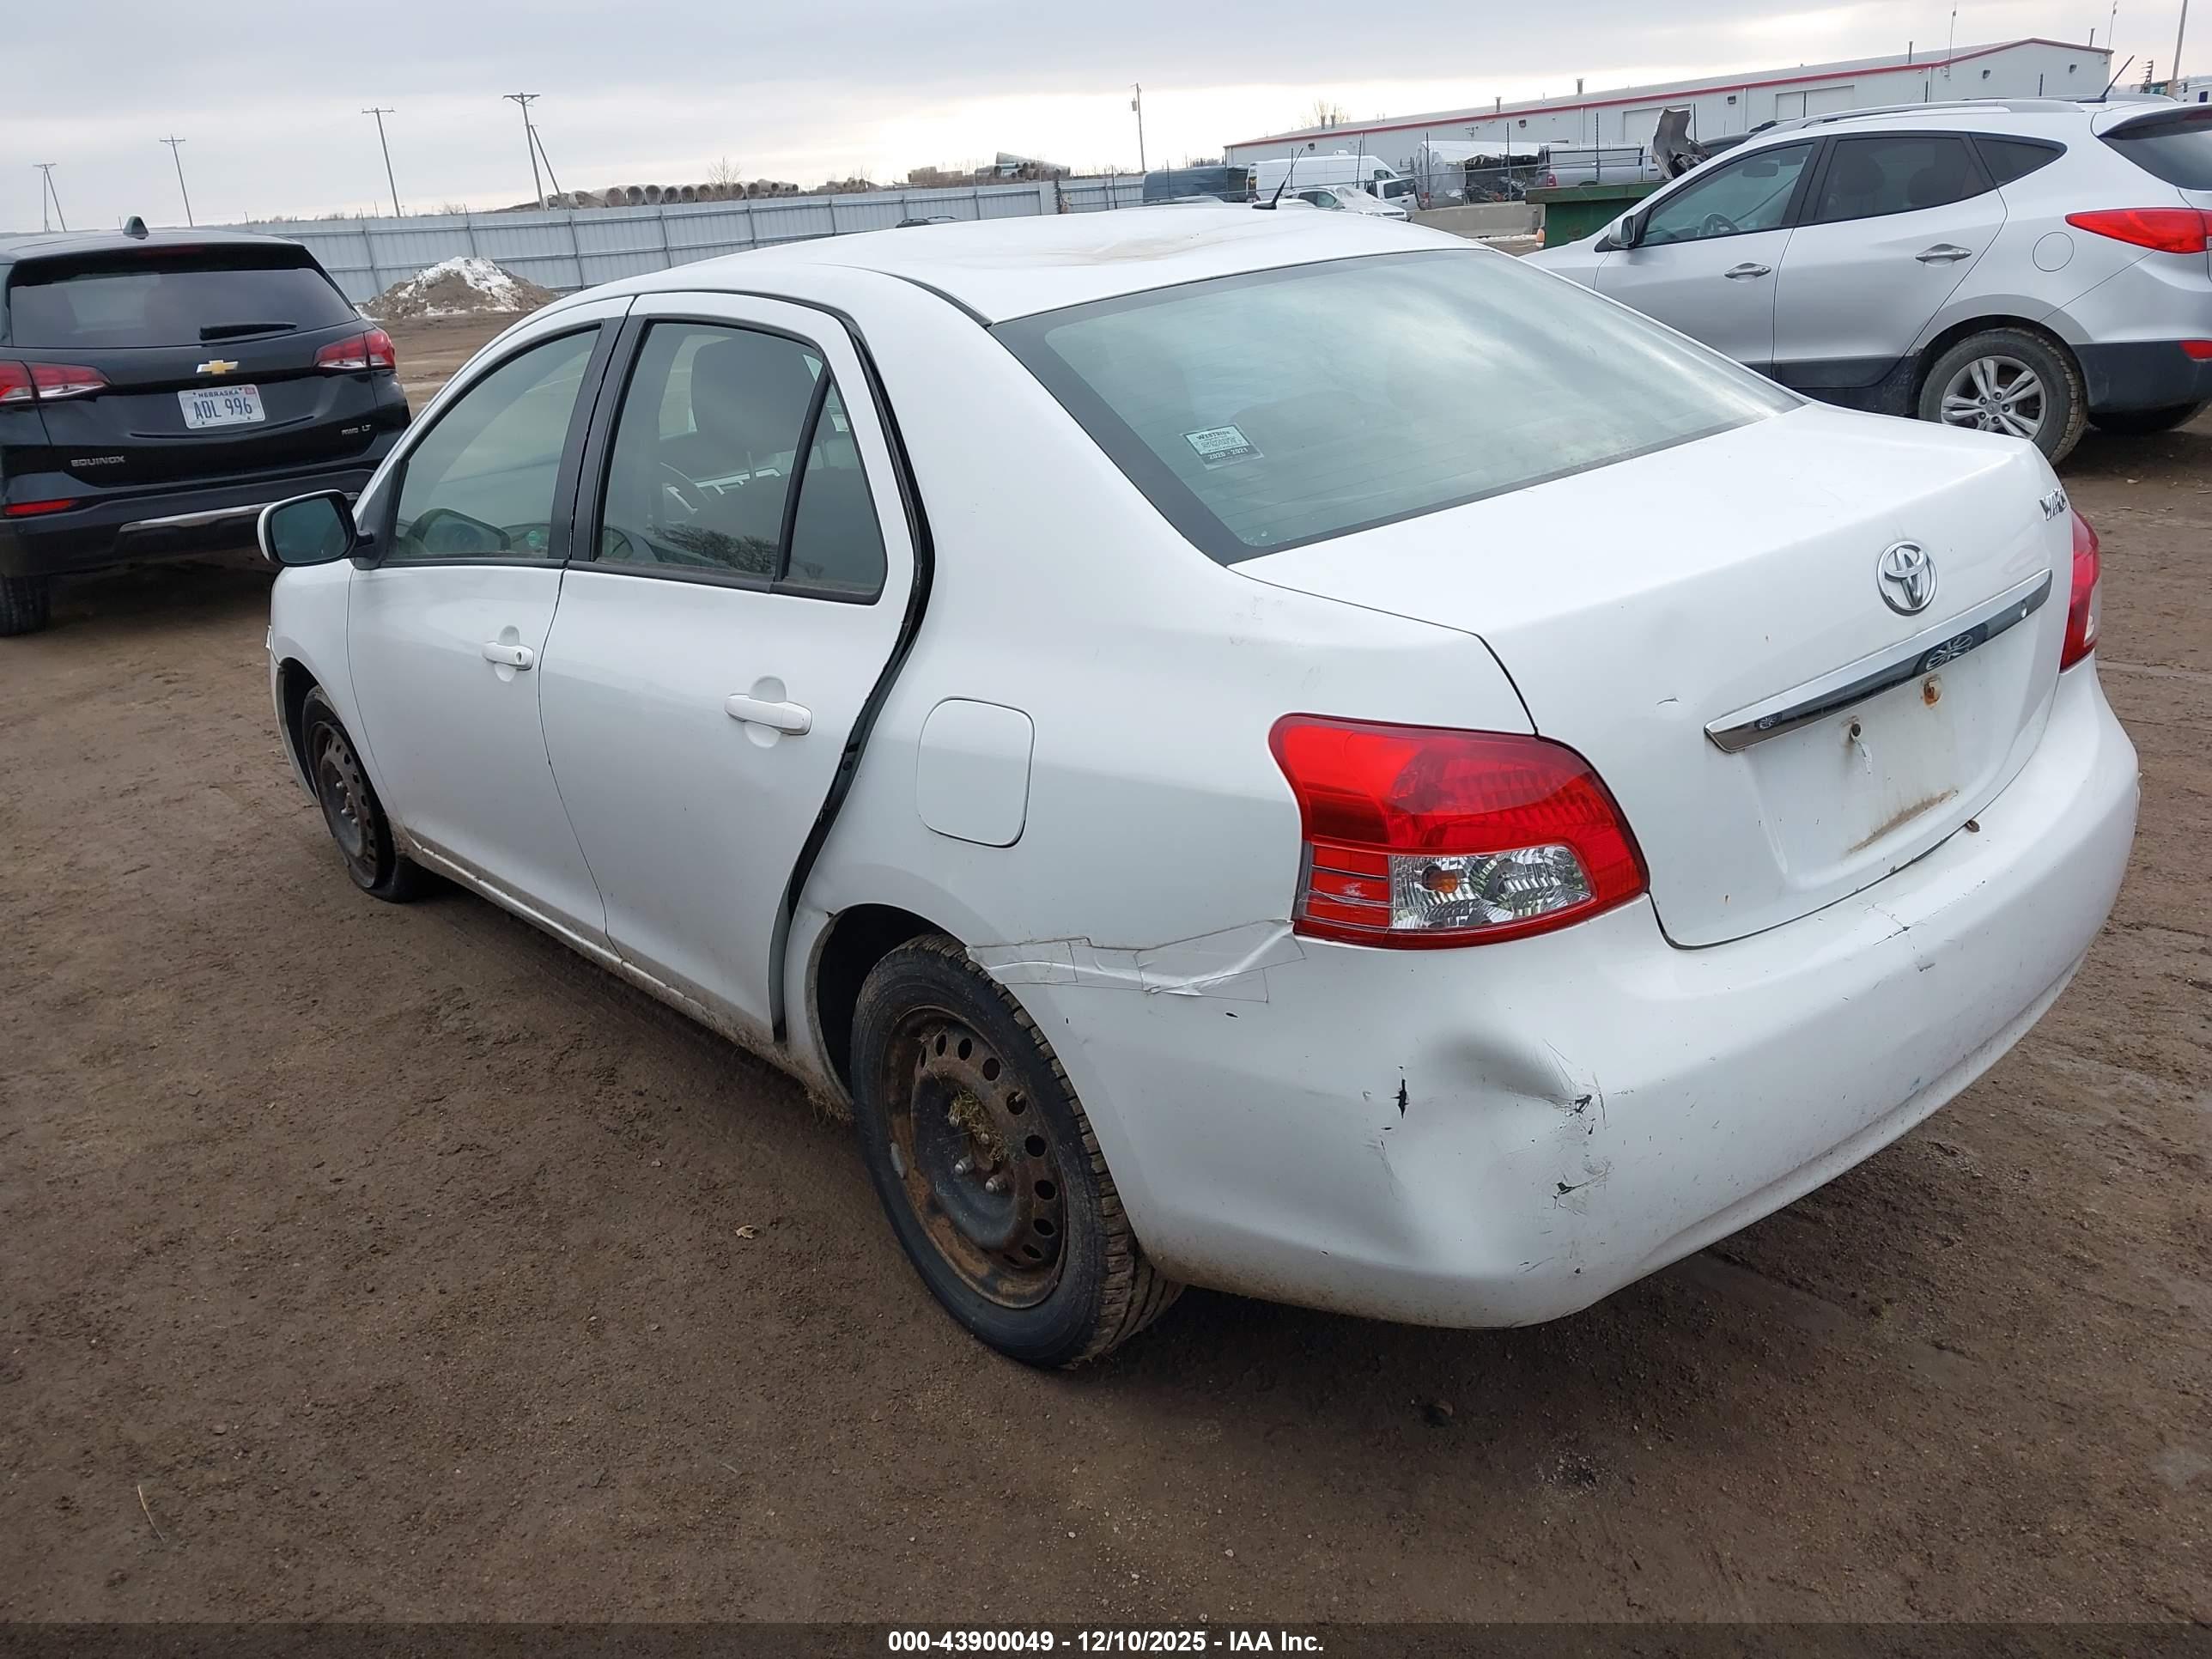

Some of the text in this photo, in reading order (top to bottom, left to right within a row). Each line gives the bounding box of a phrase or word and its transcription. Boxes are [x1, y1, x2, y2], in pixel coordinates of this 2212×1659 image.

[193, 397, 252, 420] ADL 996
[70, 455, 126, 466] EQUINOX
